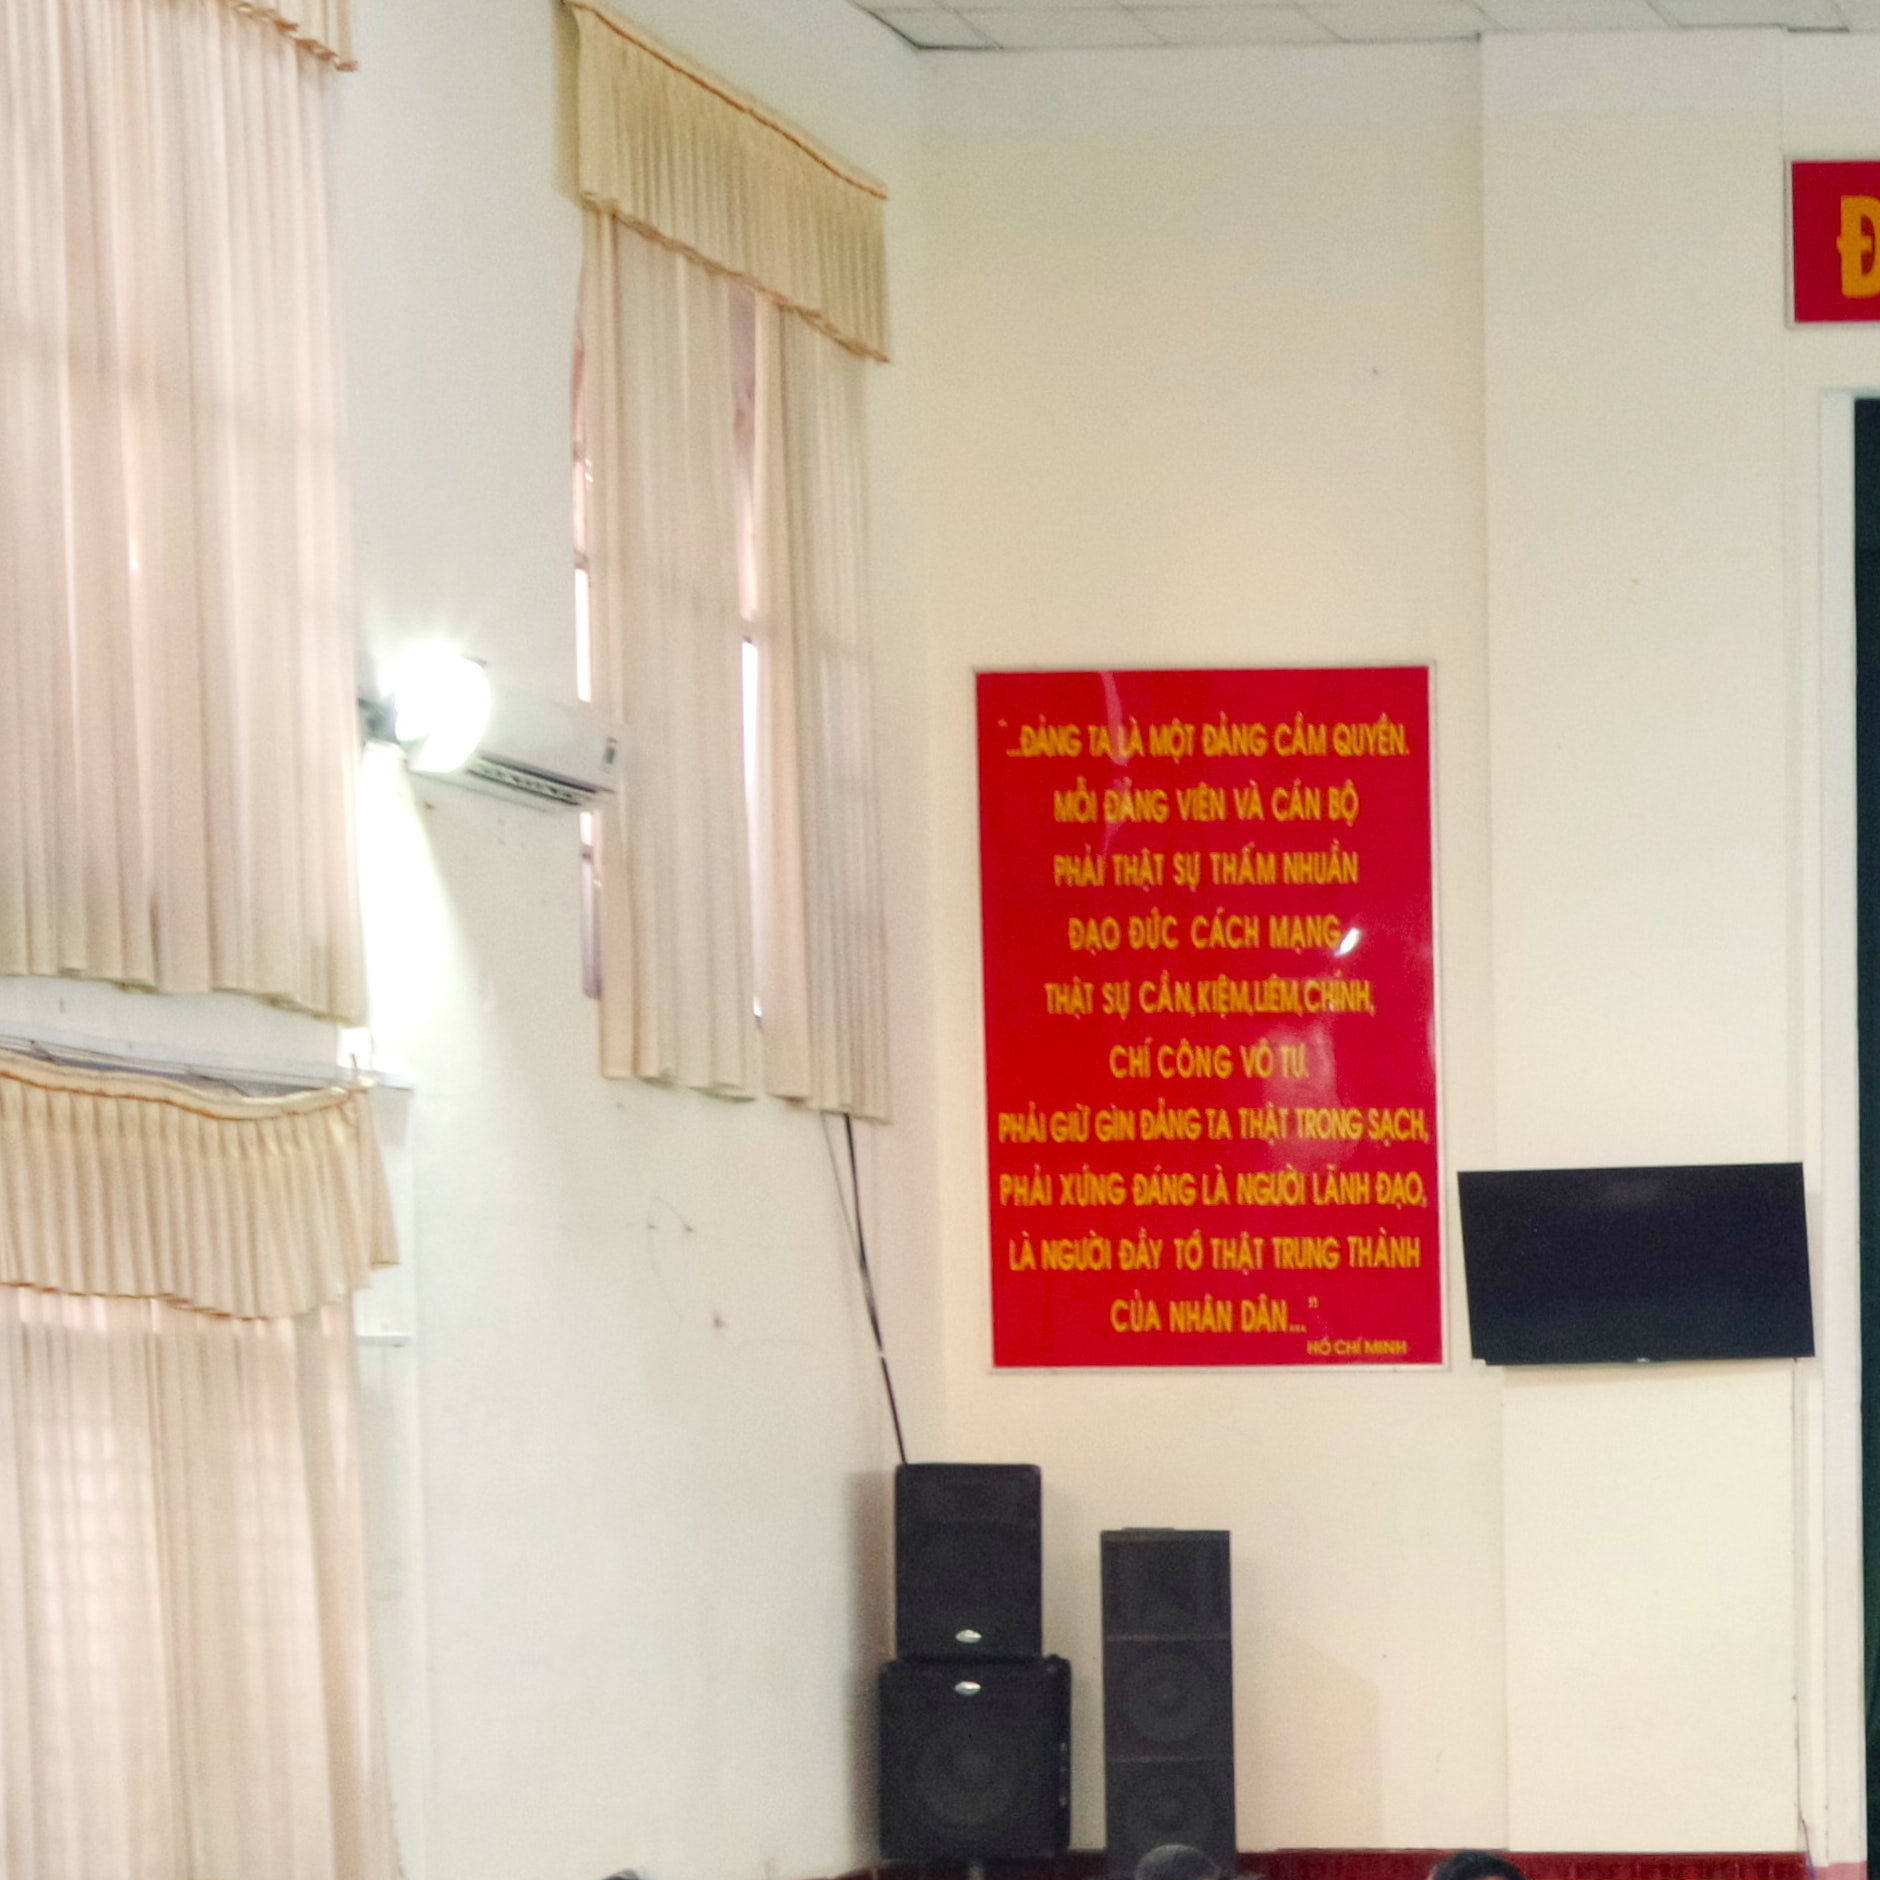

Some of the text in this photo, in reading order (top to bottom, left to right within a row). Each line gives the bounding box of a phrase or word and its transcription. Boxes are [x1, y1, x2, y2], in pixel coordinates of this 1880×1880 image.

[1205, 1107, 1233, 1139] TA
[1294, 1107, 1365, 1141] TRONG
[1271, 1236, 1342, 1270] TRUNG
